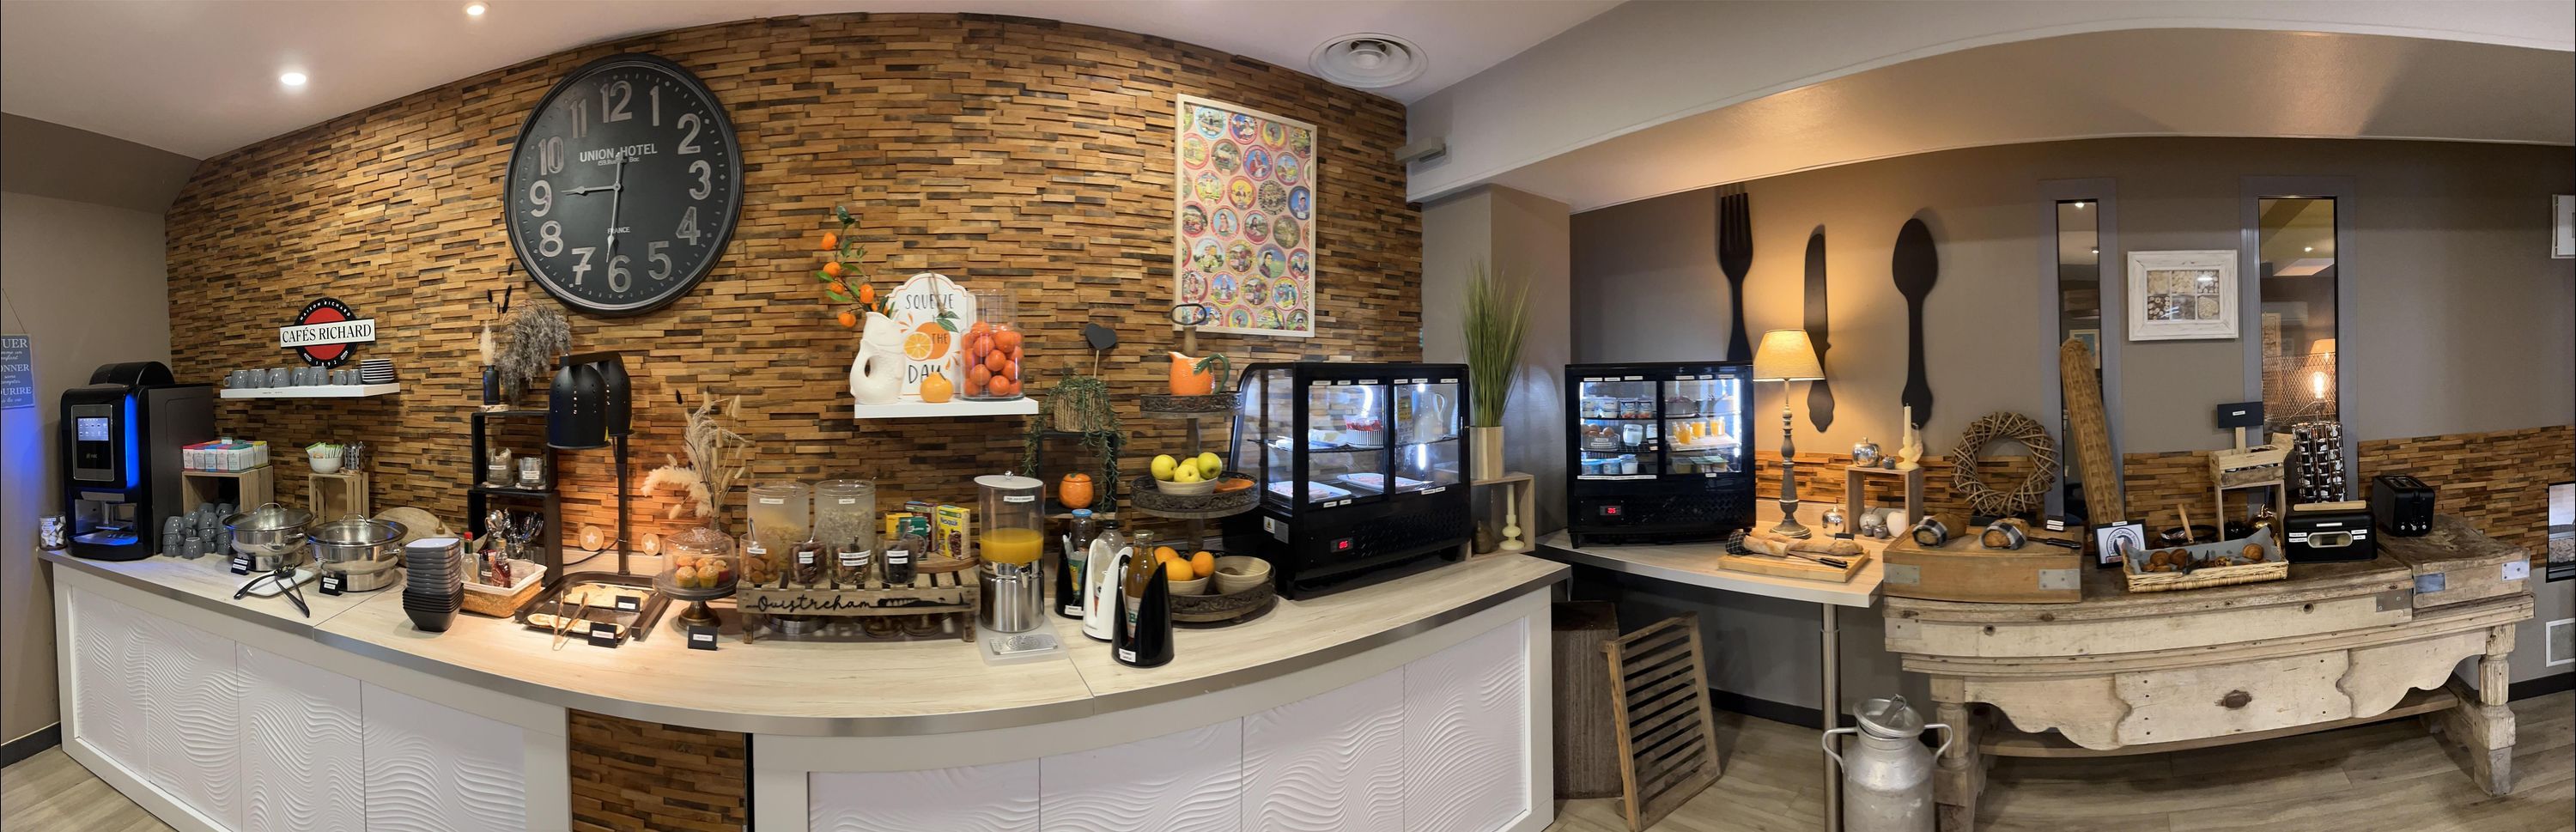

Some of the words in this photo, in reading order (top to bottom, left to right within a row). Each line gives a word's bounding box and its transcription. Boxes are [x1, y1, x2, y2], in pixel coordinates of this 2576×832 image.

[569, 98, 587, 139] 11
[600, 80, 633, 124] 12
[649, 85, 660, 127] 1
[580, 148, 615, 162] UNION
[620, 143, 658, 157] HOTEL
[677, 112, 702, 155] 2
[538, 136, 565, 176] 10
[529, 179, 553, 217] 9
[688, 160, 712, 201] 3
[538, 220, 564, 258] 8
[675, 205, 702, 246] 4
[571, 246, 597, 285] 7
[607, 254, 632, 293] 6
[647, 240, 672, 281] 5
[300, 301, 321, 321] MAISON
[324, 300, 351, 317] RICHARD
[282, 327, 316, 343] CAFÉS
[319, 324, 372, 341] RICHARD
[932, 333, 948, 344] THE
[1, 386, 32, 396] URIRE
[757, 594, 870, 613] Ouistreham
